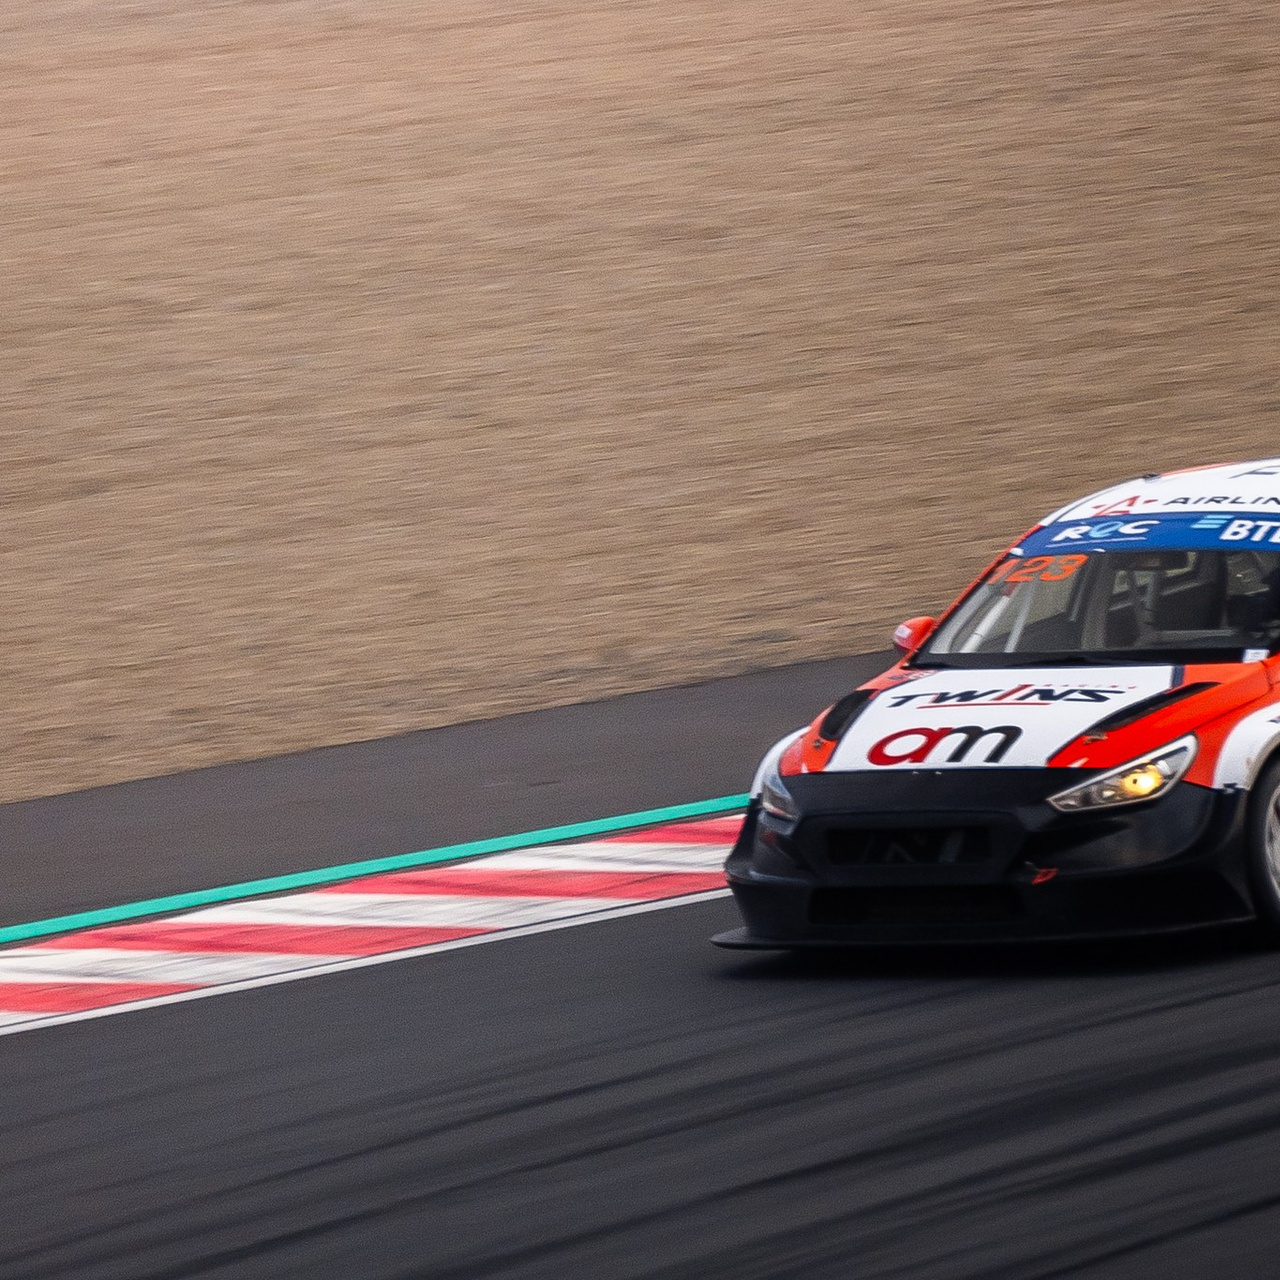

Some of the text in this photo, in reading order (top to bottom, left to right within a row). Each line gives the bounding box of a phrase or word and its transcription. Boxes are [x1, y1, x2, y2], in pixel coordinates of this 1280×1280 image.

[987, 553, 1089, 585] 123
[886, 683, 1126, 709] TWINS
[866, 724, 1024, 766] am
